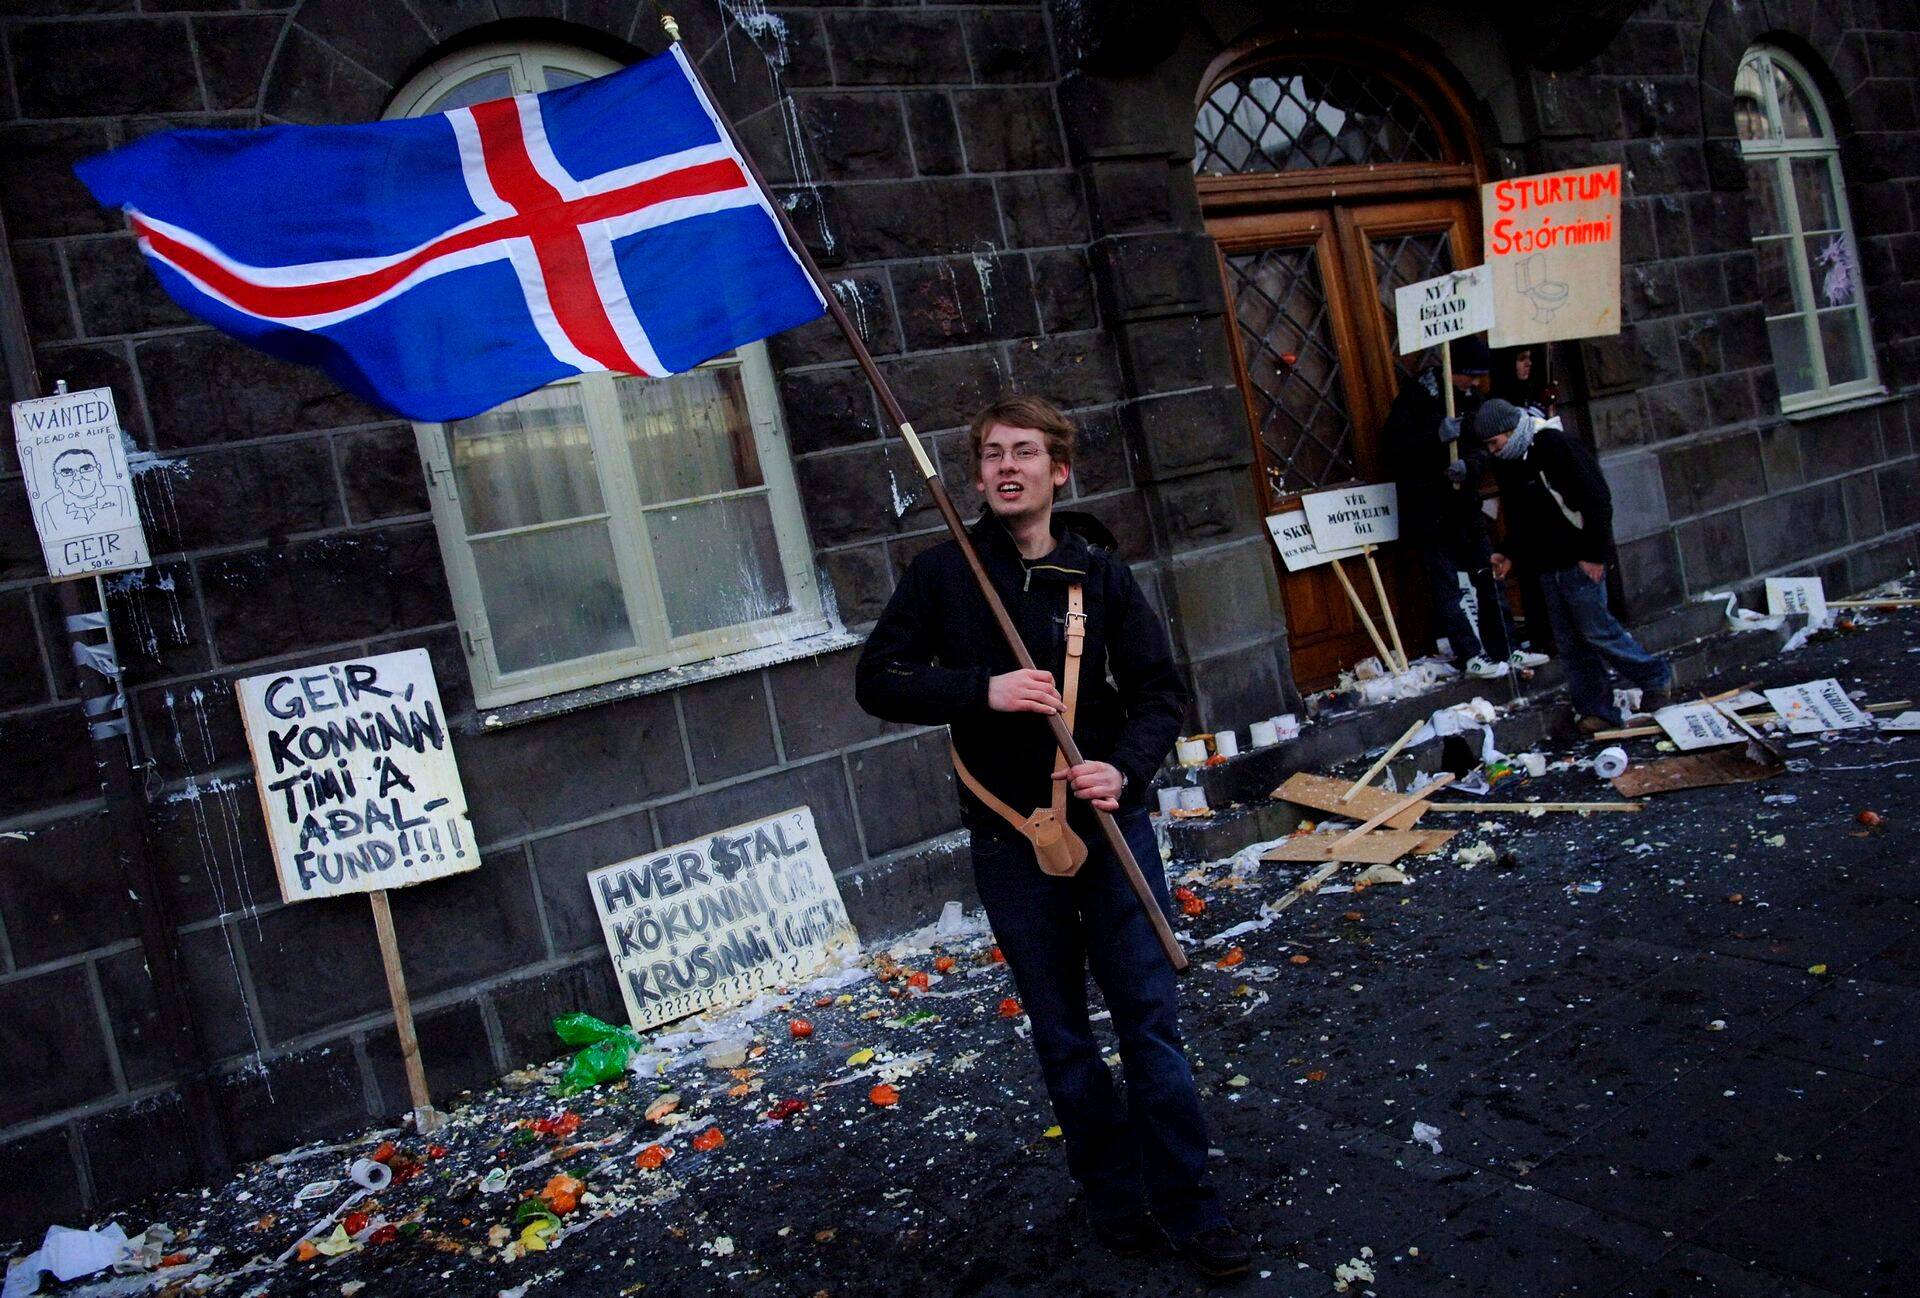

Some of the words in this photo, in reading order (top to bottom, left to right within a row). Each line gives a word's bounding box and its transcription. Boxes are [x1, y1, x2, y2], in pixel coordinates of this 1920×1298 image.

[1495, 169, 1618, 213] STURTUM
[24, 401, 110, 431] WANTED
[36, 434, 65, 446] DEAD
[67, 431, 80, 439] OR
[64, 533, 120, 565] GEIR
[597, 849, 713, 916] HVER
